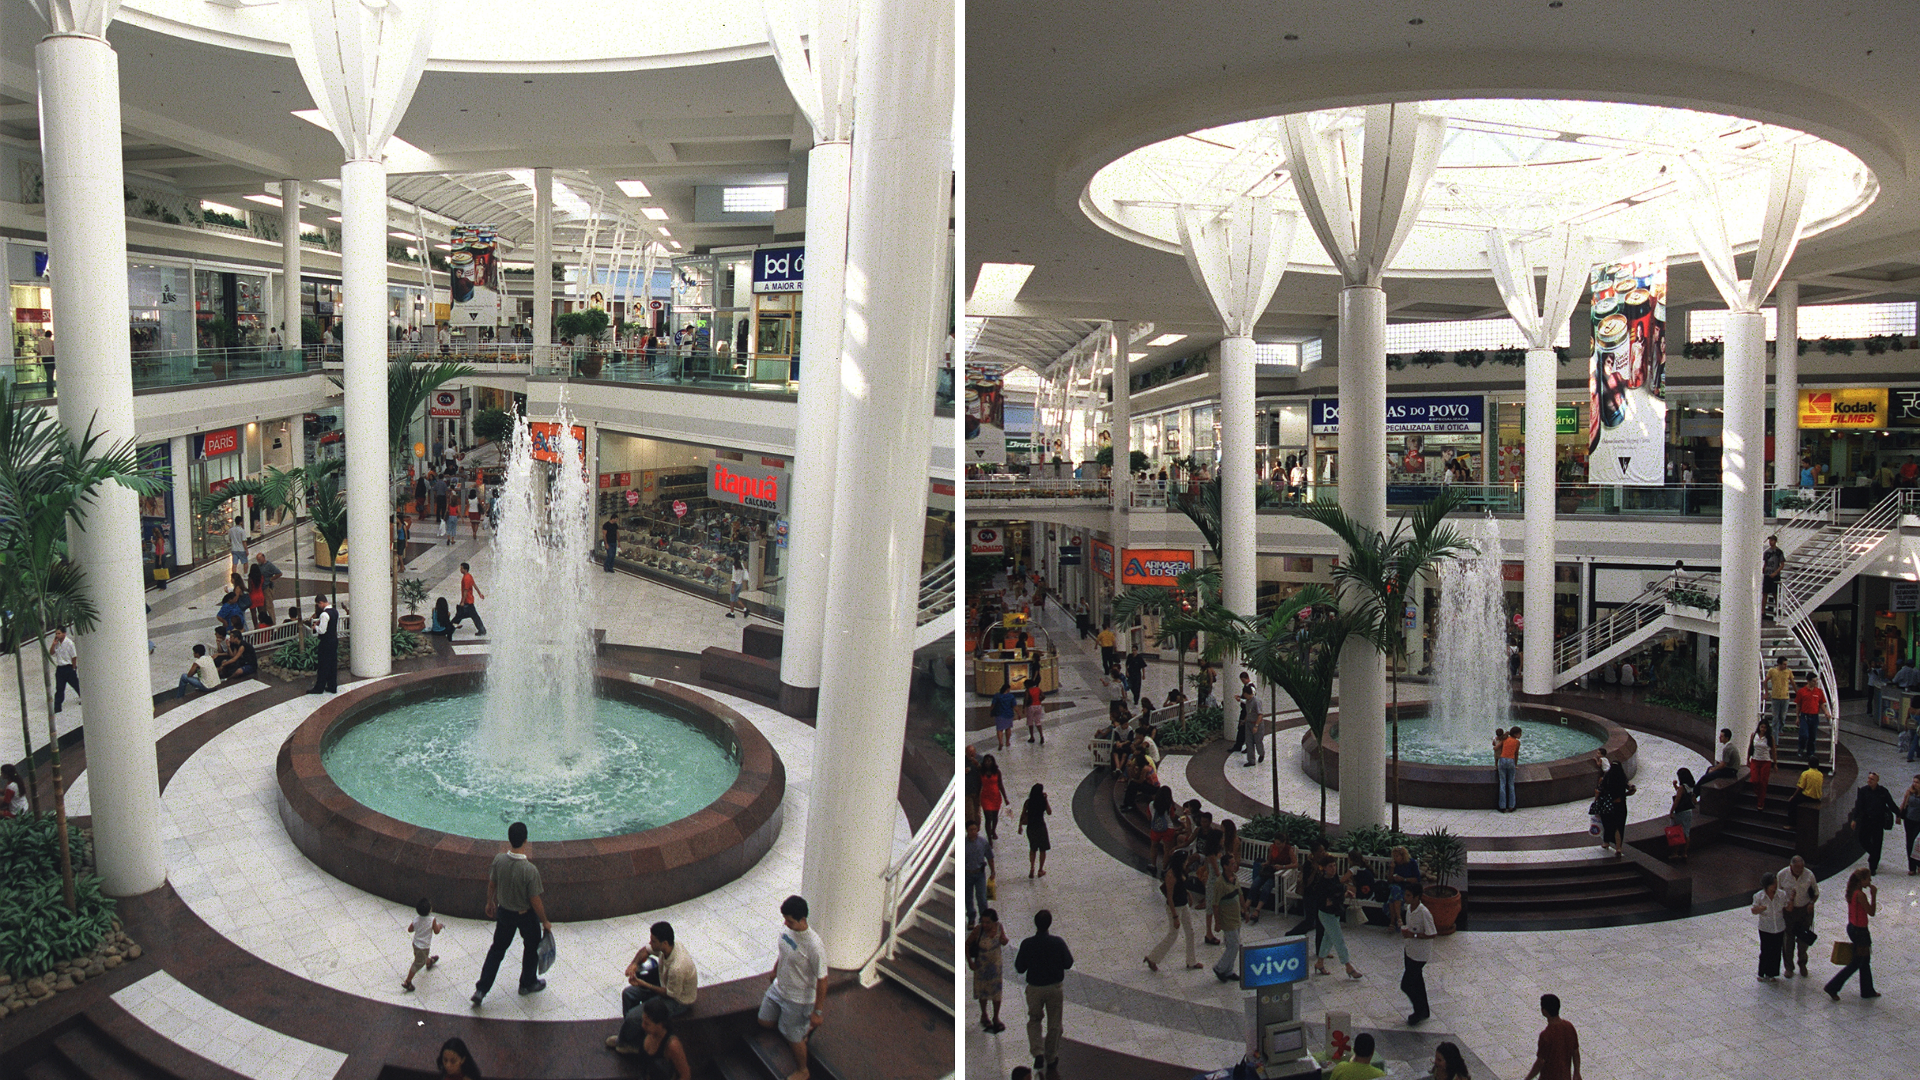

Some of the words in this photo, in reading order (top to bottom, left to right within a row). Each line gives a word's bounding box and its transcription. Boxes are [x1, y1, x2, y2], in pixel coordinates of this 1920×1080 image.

[772, 282, 794, 290] MAIOR
[1410, 407, 1425, 416] DO
[1428, 404, 1470, 417] POVO
[1834, 402, 1877, 413] Kodak
[1556, 415, 1575, 425] ário
[1830, 414, 1875, 423] FILMES
[208, 435, 234, 452] PARIS
[714, 463, 777, 504] itapuã
[1149, 568, 1163, 576] DO
[1250, 956, 1300, 976] vivo
